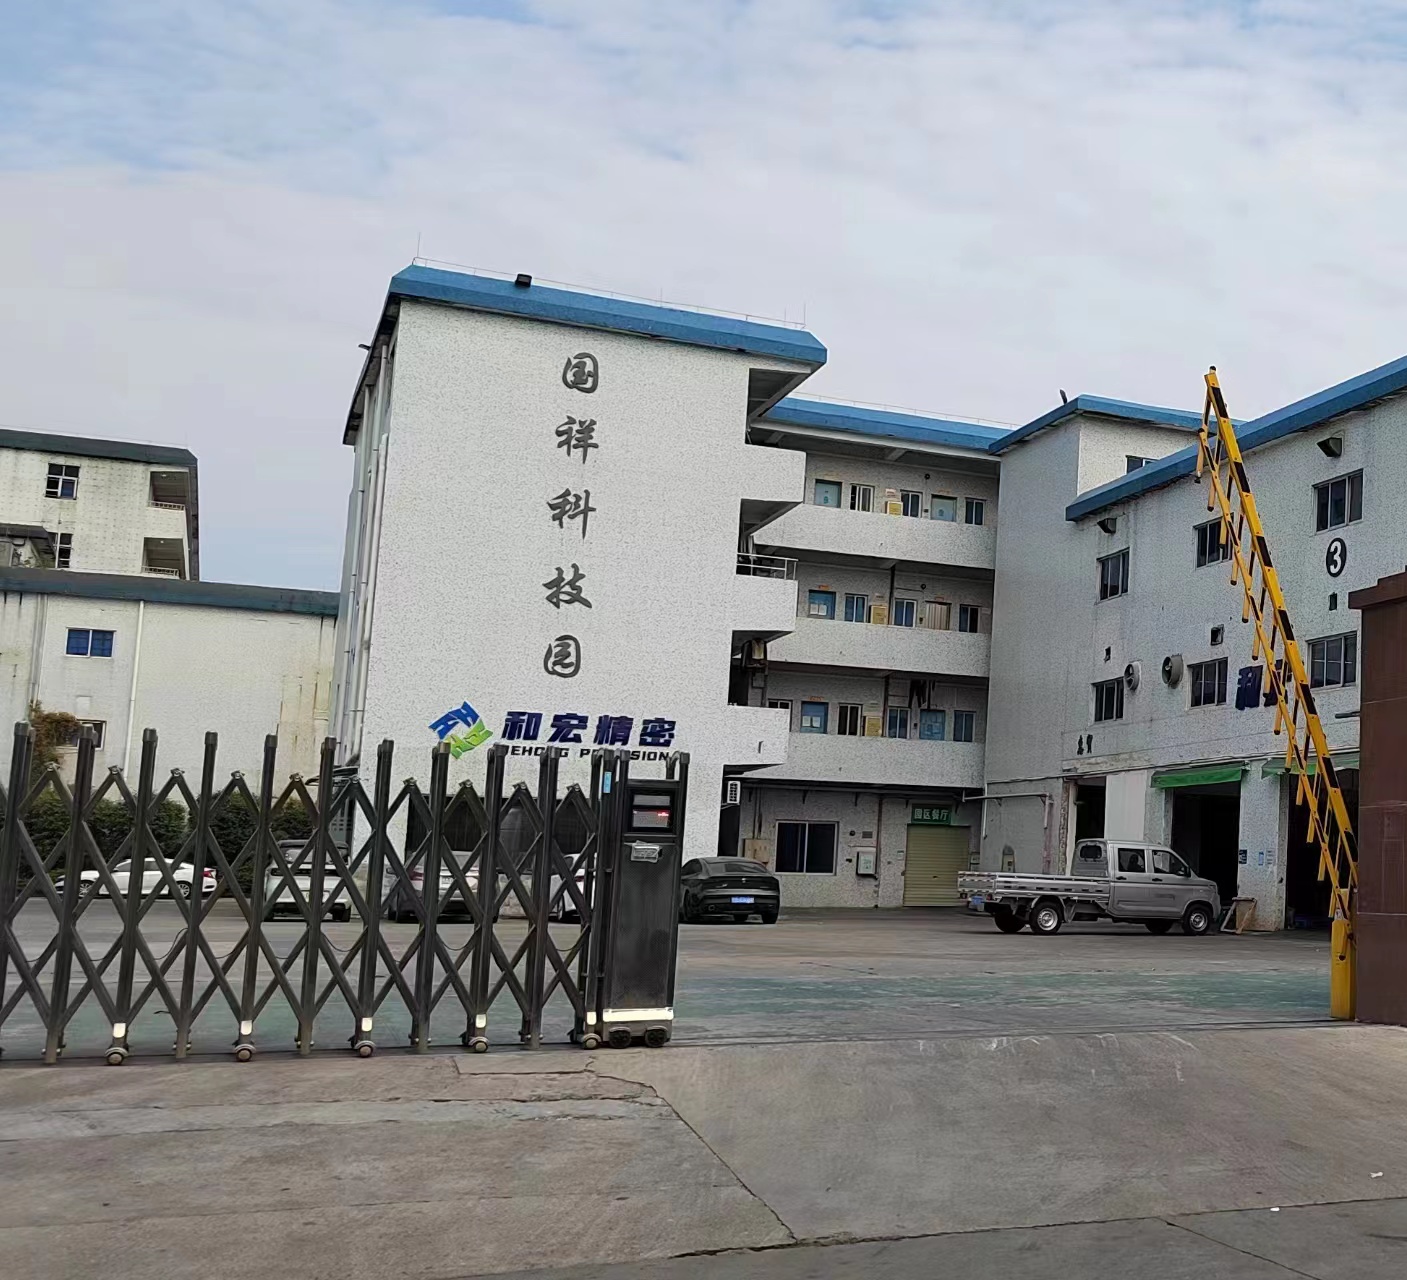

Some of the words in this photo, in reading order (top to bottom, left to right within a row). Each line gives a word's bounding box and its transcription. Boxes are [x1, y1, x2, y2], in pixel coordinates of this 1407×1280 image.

[542, 352, 600, 679] 国祥科技园
[1329, 540, 1342, 574] 3
[501, 711, 676, 748] 和宏精密
[914, 808, 949, 821] 园区餐厅
